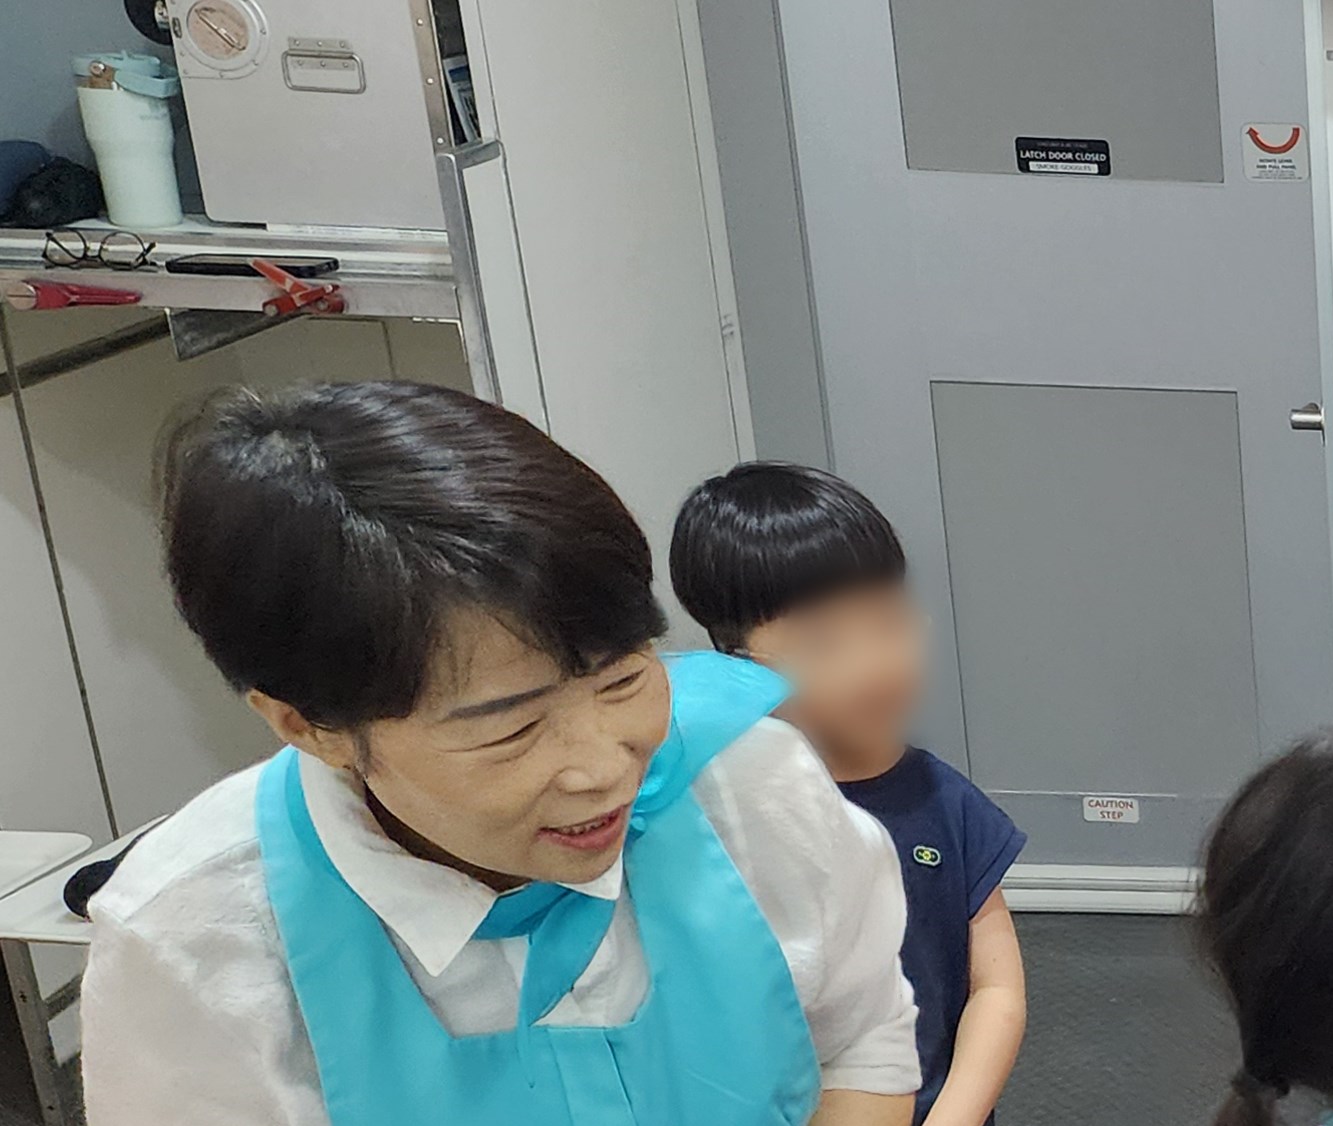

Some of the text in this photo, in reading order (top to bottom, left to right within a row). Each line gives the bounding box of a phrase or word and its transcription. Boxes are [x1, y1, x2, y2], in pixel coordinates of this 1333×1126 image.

[1020, 150, 1107, 162] LATCH DOOR CLOSED
[1088, 799, 1134, 809] CAUTION
[1099, 810, 1124, 819] STEP
